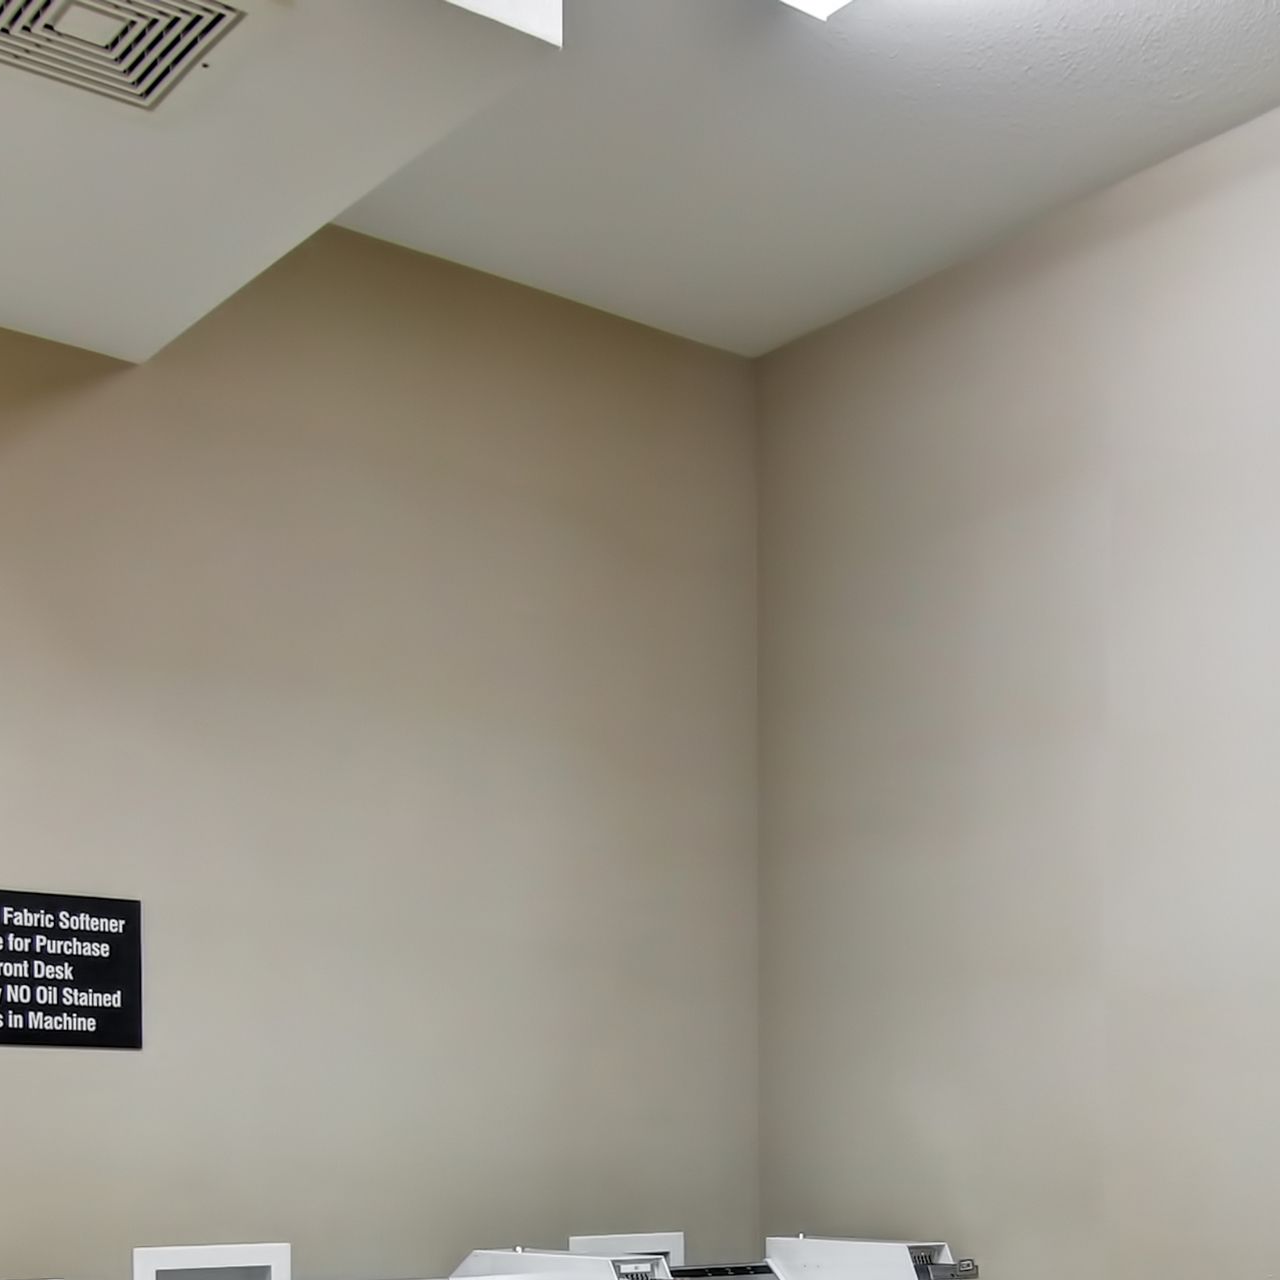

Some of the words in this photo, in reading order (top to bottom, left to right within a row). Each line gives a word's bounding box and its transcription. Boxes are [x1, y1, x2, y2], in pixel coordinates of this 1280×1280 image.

[2, 906, 55, 929] Fabric
[58, 910, 126, 934] Softener
[6, 932, 32, 952] for
[35, 934, 111, 958] Purchase
[33, 959, 74, 980] Desk
[6, 984, 31, 1004] NO
[35, 985, 58, 1005] Oil
[61, 987, 122, 1008] Stained
[7, 1010, 24, 1029] in
[27, 1011, 97, 1032] Machine
